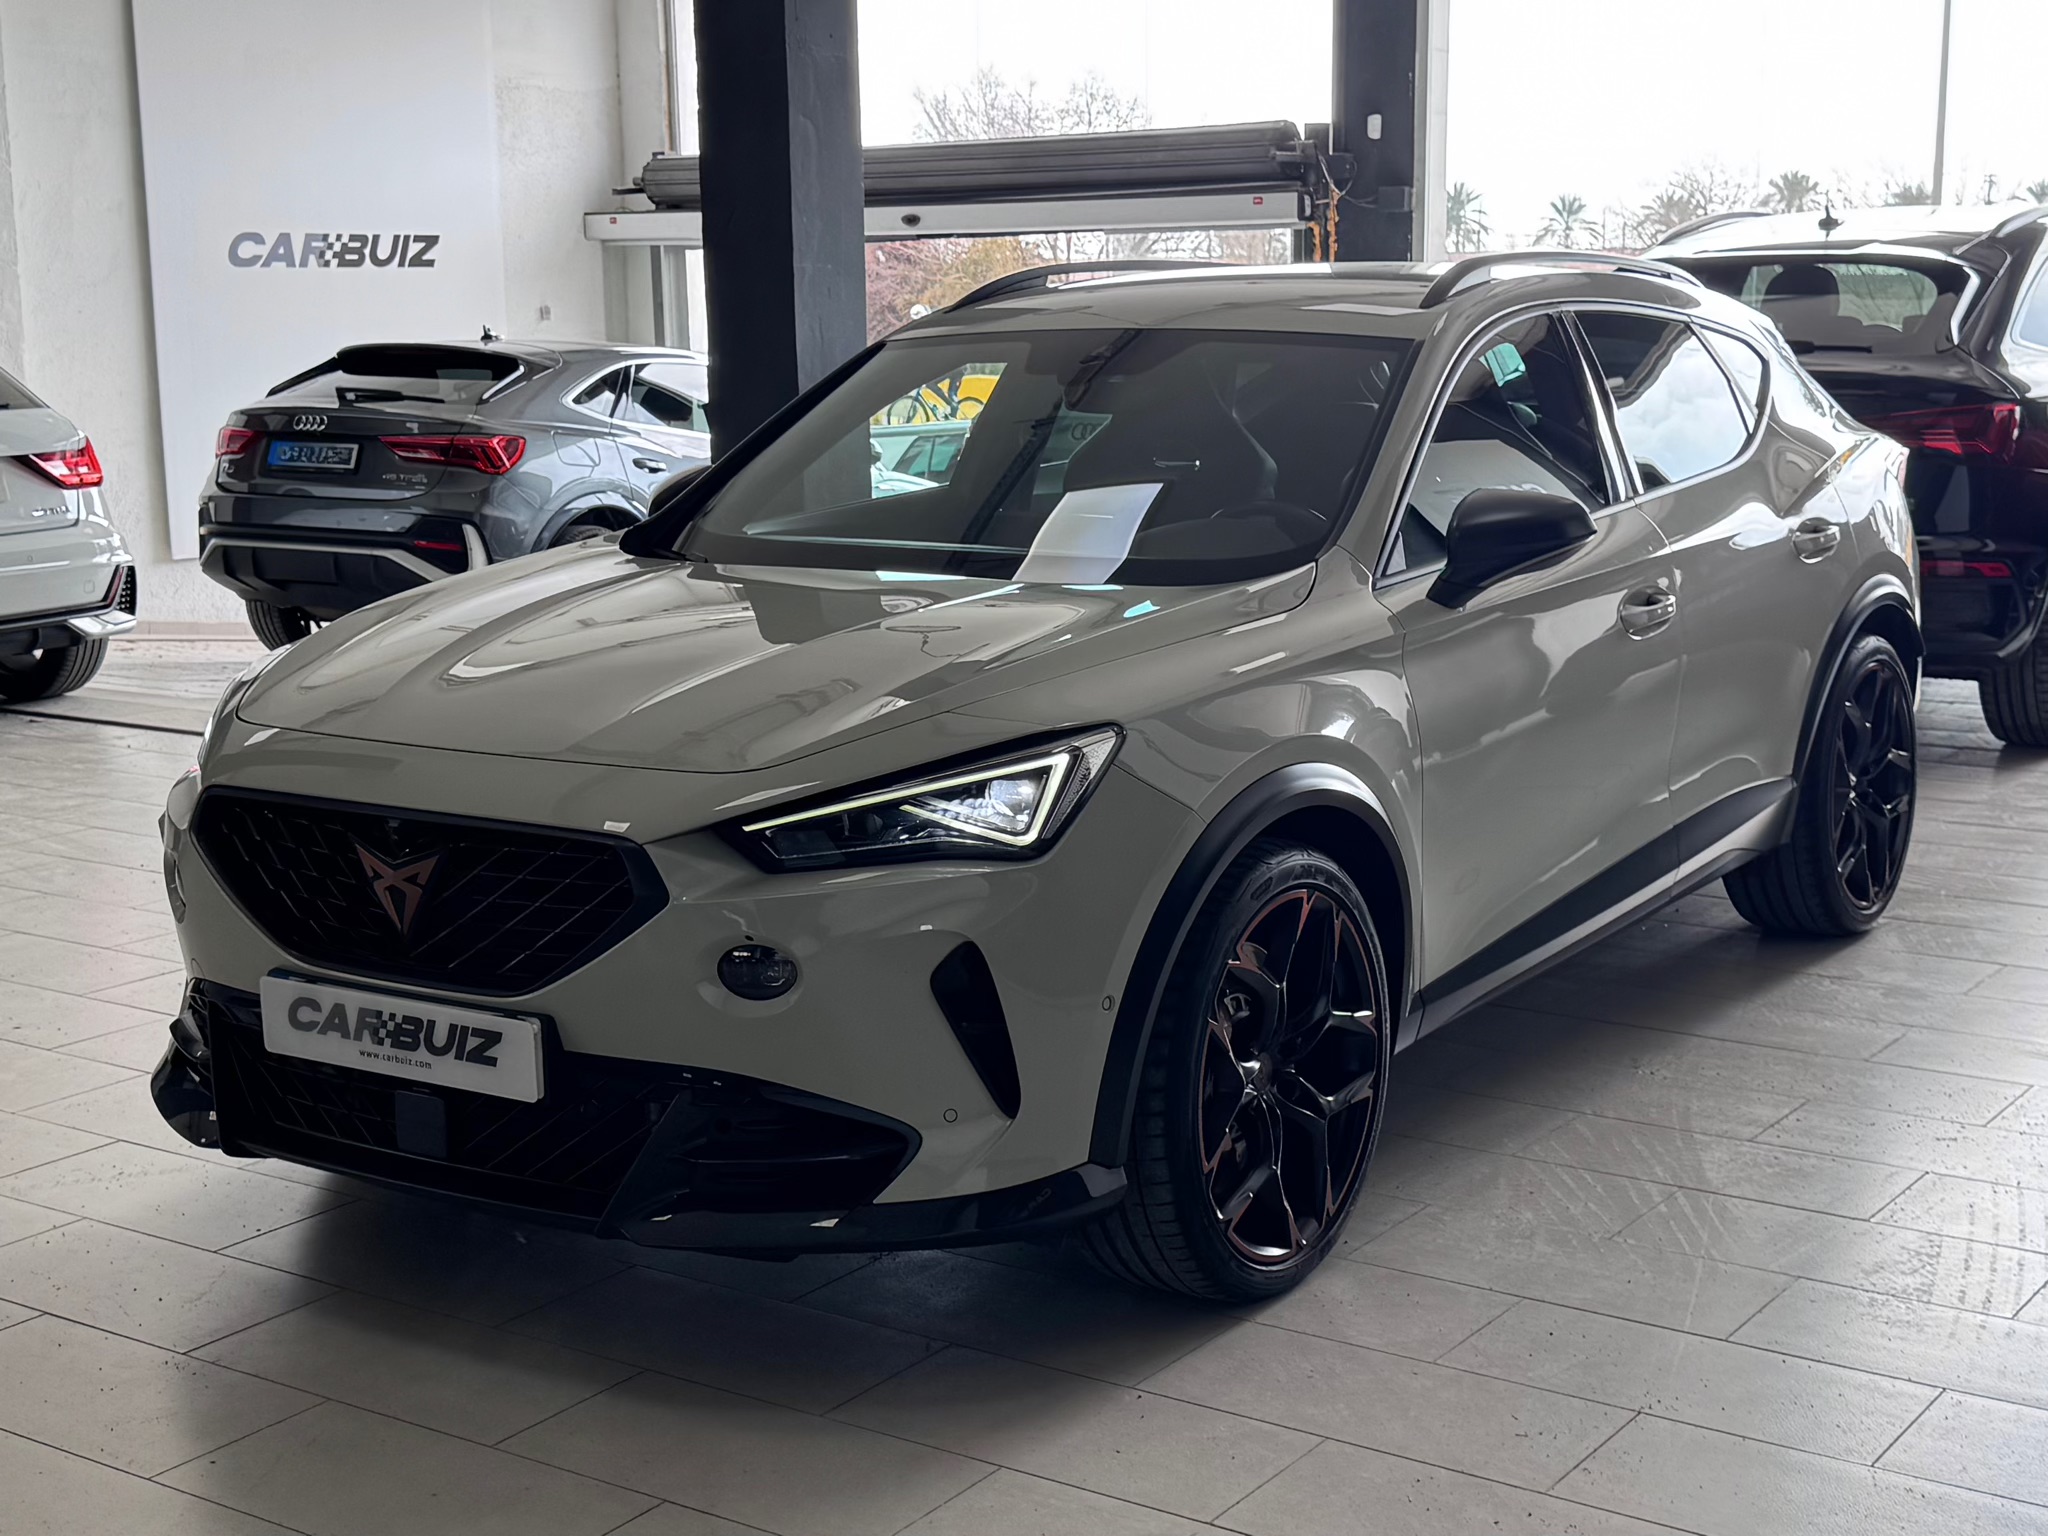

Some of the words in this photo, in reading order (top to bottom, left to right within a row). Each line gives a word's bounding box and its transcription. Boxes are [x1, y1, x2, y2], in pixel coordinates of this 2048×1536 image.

[228, 231, 441, 268] CARBUIZ
[287, 996, 503, 1067] CARBUIZ
[359, 1049, 432, 1069] www.carbuiz.com
